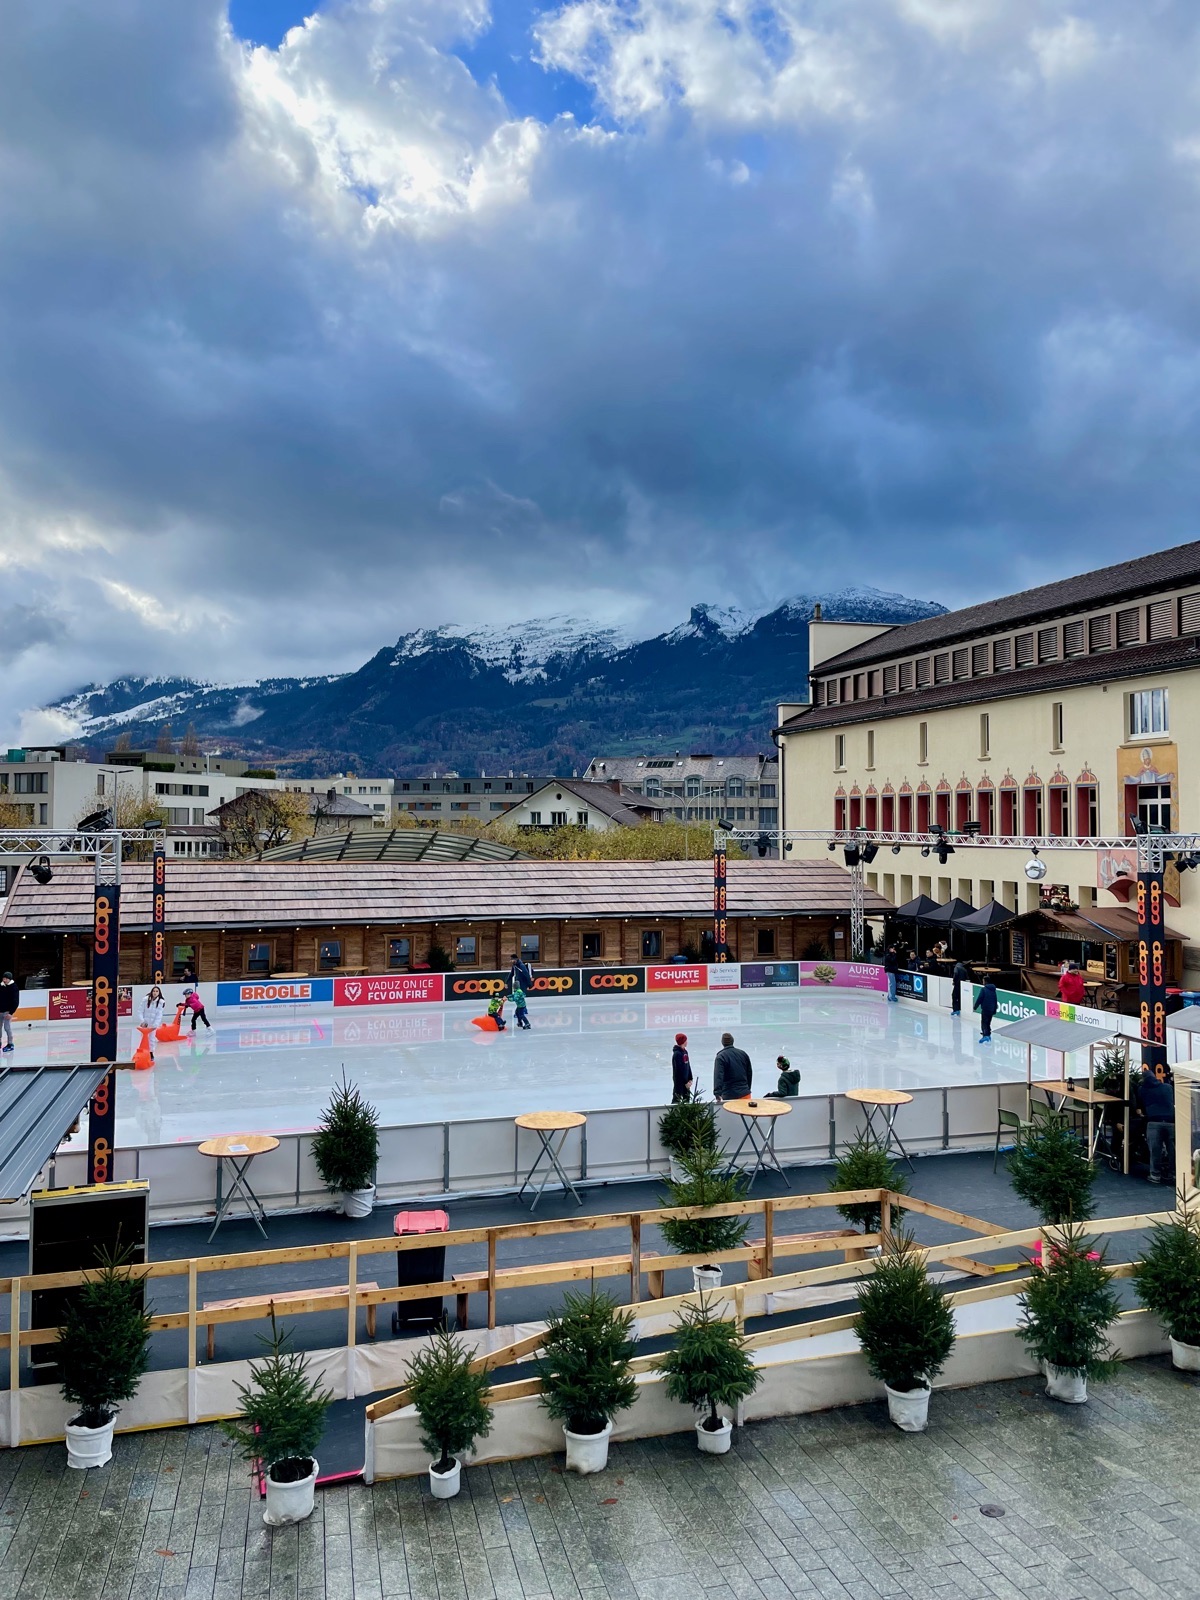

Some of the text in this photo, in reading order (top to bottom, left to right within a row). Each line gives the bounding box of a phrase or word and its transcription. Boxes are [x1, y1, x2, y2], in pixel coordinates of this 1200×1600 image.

[156, 856, 165, 885] coop
[155, 894, 165, 922] coop
[1137, 880, 1147, 925] coop
[1151, 881, 1162, 925] coop
[94, 896, 113, 954] coop
[155, 932, 164, 961] coop
[654, 970, 700, 980] SCHURTE
[848, 965, 880, 976] AUHOF
[1139, 940, 1149, 986] coop
[1153, 941, 1163, 986] coop
[241, 983, 311, 1001] BROGLE
[367, 979, 434, 990] VADUZ ON ICE
[367, 990, 427, 1001] FCV ON FIRE
[452, 979, 505, 996] coop
[527, 976, 573, 993] oop
[590, 973, 638, 990] coop
[95, 976, 113, 1035] coop
[1049, 1006, 1100, 1026] Ideenkanal.com
[93, 1137, 112, 1183] oop
